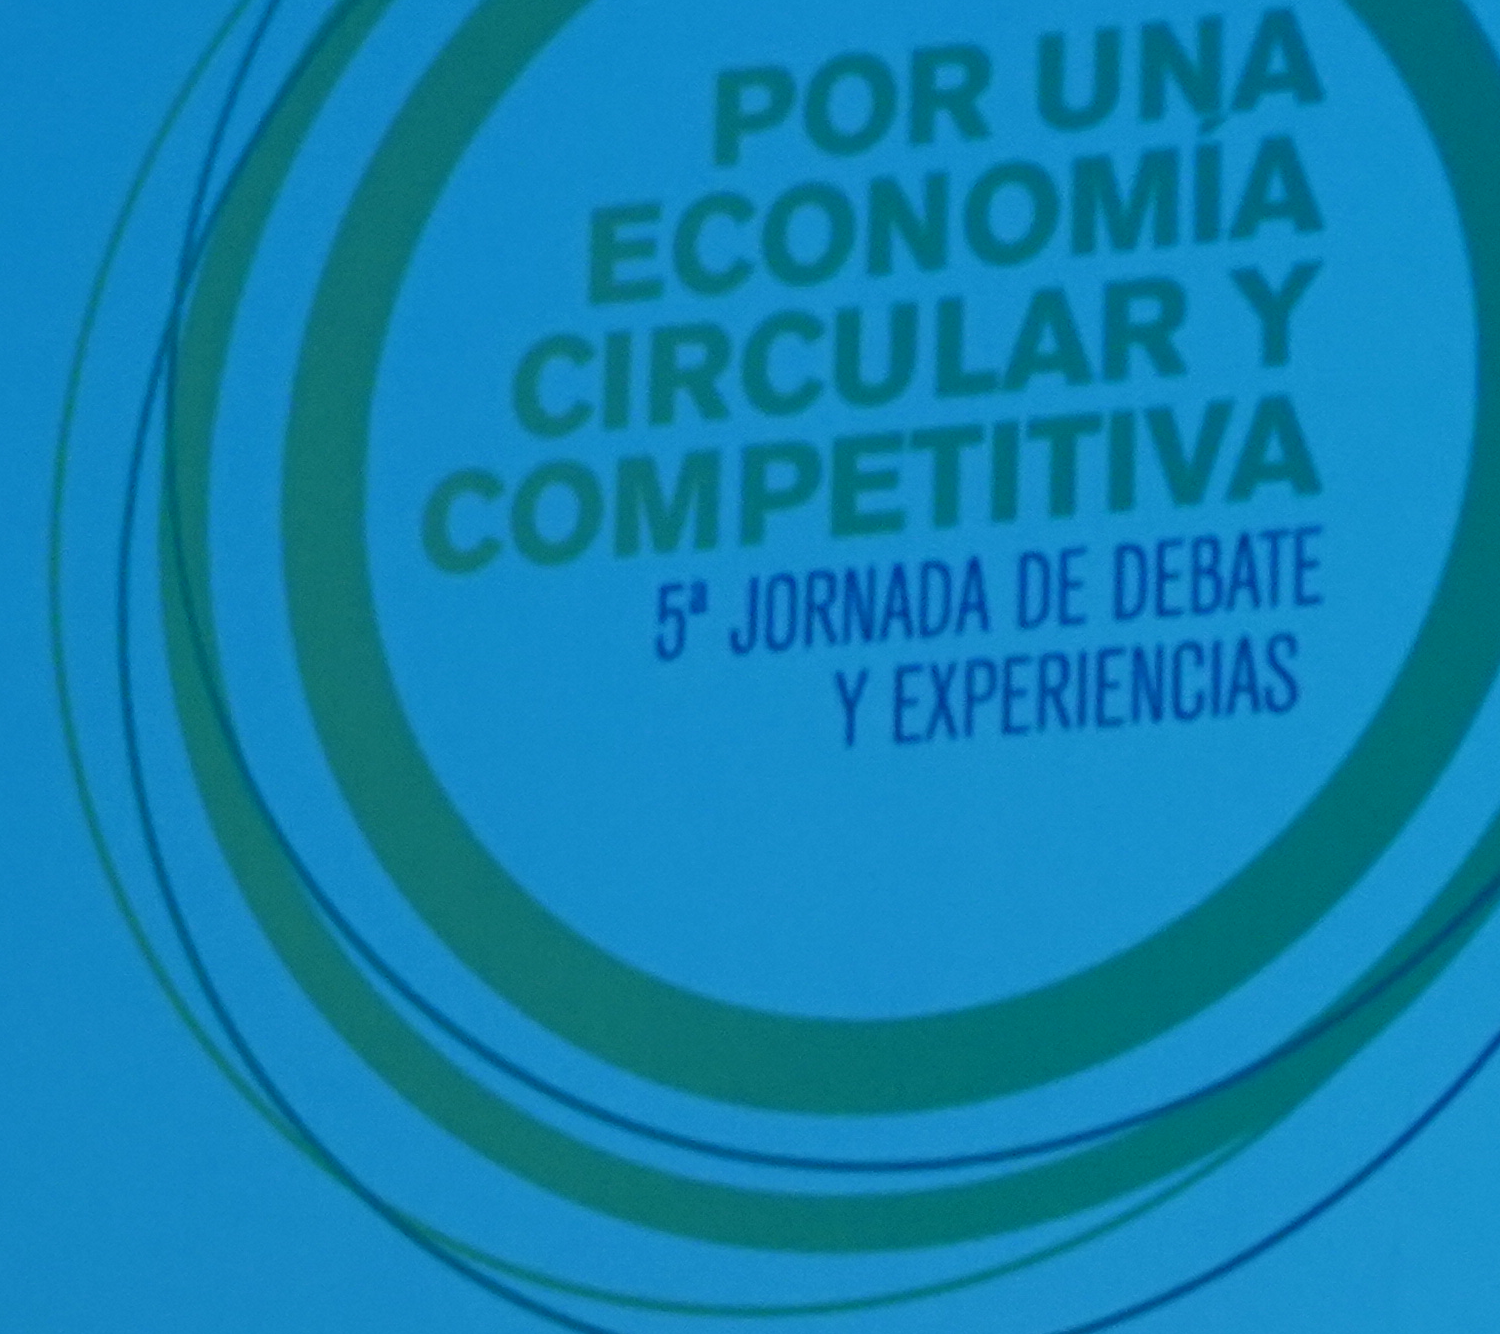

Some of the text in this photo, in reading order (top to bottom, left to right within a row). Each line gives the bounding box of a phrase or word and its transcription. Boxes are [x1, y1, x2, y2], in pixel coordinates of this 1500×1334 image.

[711, 6, 1325, 167] POR UNA
[586, 115, 1325, 307] ECONOMÍA
[511, 259, 1323, 438] CIRCULAR Y
[420, 394, 1323, 575] COMPETITIVA
[730, 556, 990, 655] JORNADA
[1018, 546, 1086, 630] DE
[1114, 526, 1323, 622] DEBATE
[835, 632, 1299, 748] Y EXPERIENCIAS
